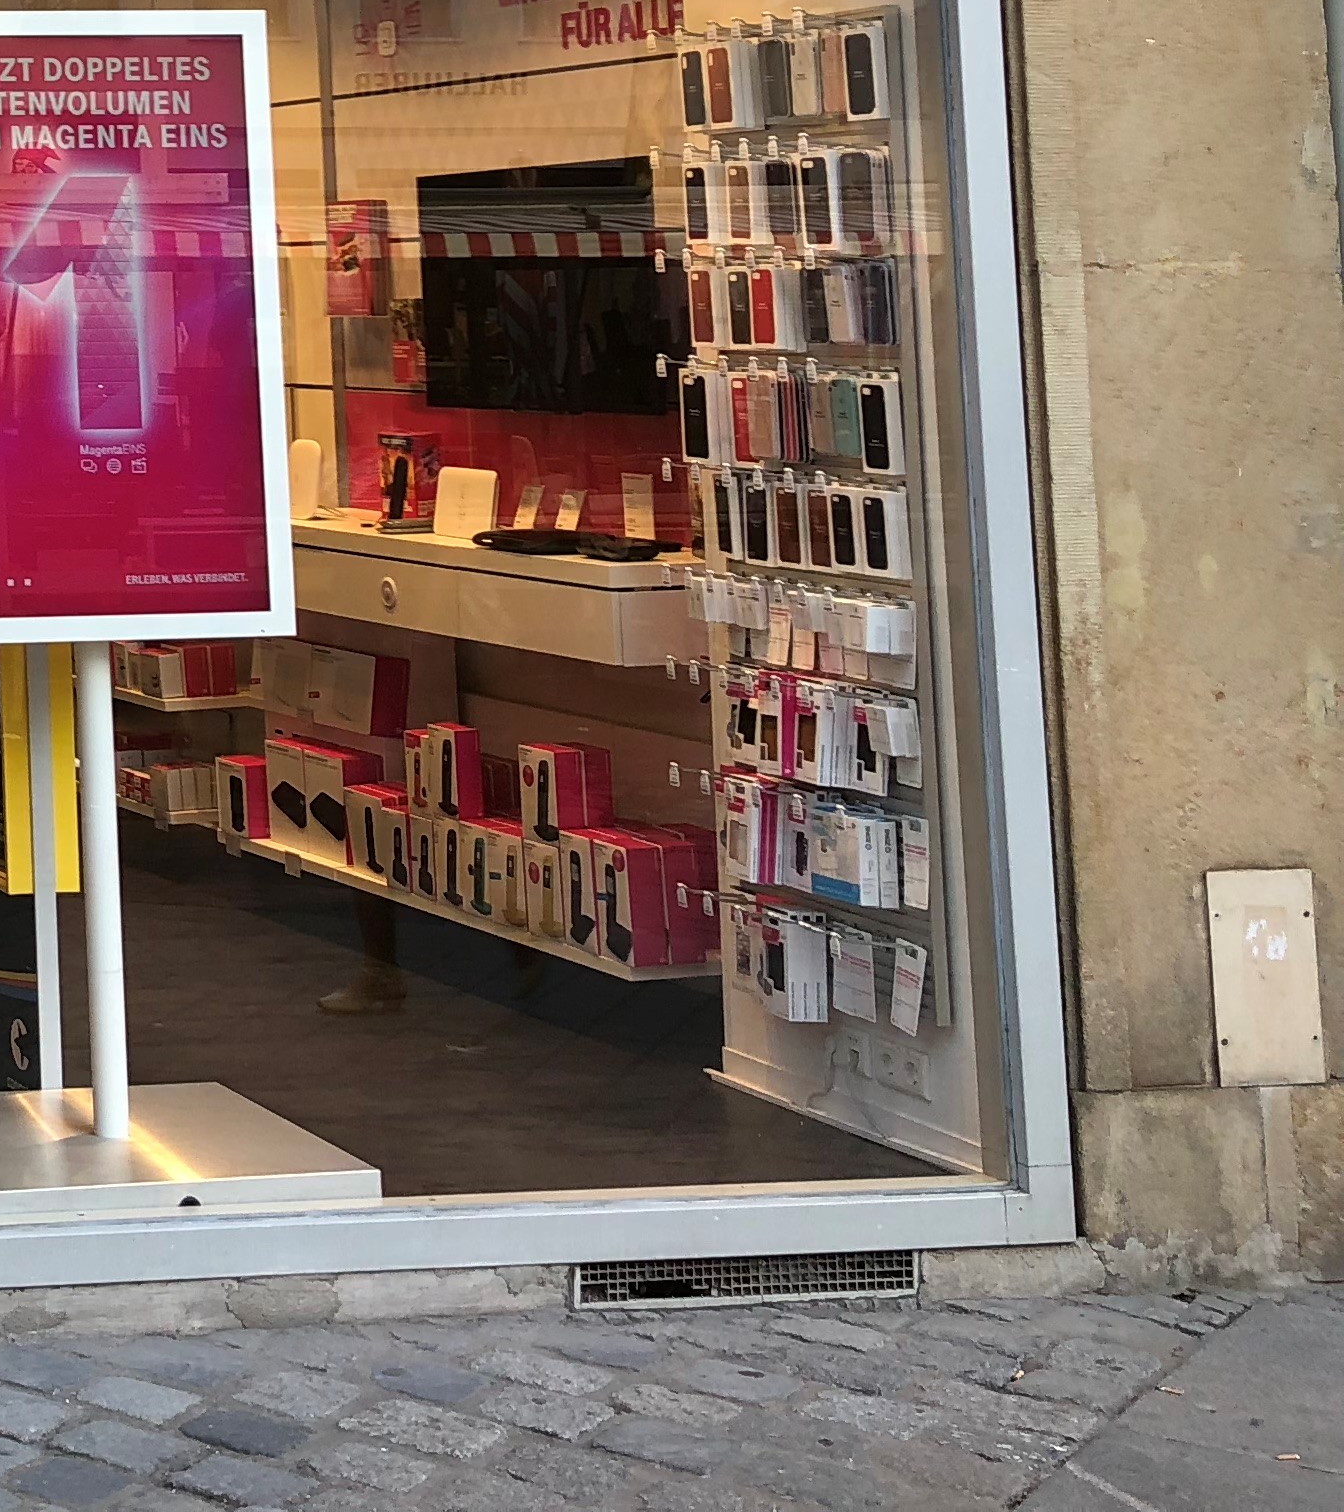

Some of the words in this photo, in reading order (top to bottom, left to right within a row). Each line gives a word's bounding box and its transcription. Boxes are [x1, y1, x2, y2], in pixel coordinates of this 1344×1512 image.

[561, 0, 614, 50] FÜR
[43, 56, 211, 82] DOPPELTES
[11, 124, 153, 150] MAGENTA
[160, 123, 228, 149] EINS
[125, 573, 172, 585] ERLEBEN,
[172, 573, 193, 585] WAS
[193, 572, 249, 584] VERBINDET.
